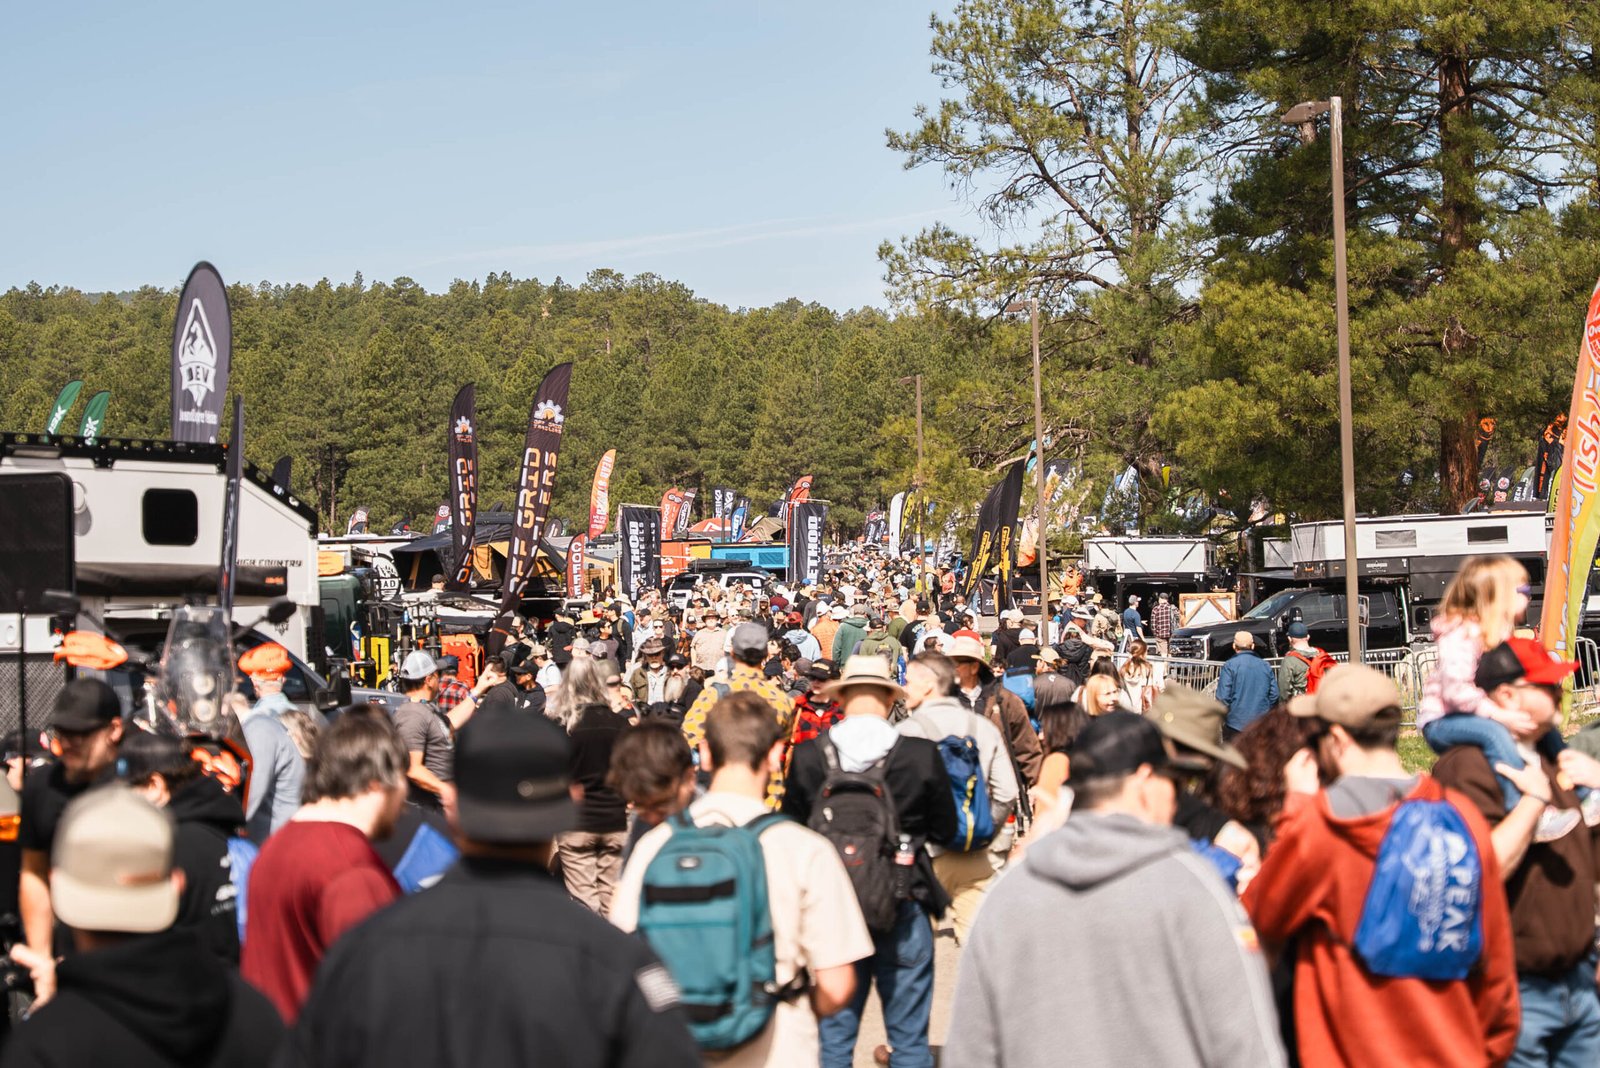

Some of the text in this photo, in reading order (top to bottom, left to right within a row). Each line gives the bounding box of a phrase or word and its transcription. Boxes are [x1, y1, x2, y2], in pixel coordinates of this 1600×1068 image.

[516, 447, 541, 529] GRID
[258, 559, 303, 567] COUNTRY
[571, 541, 583, 598] COFFE
